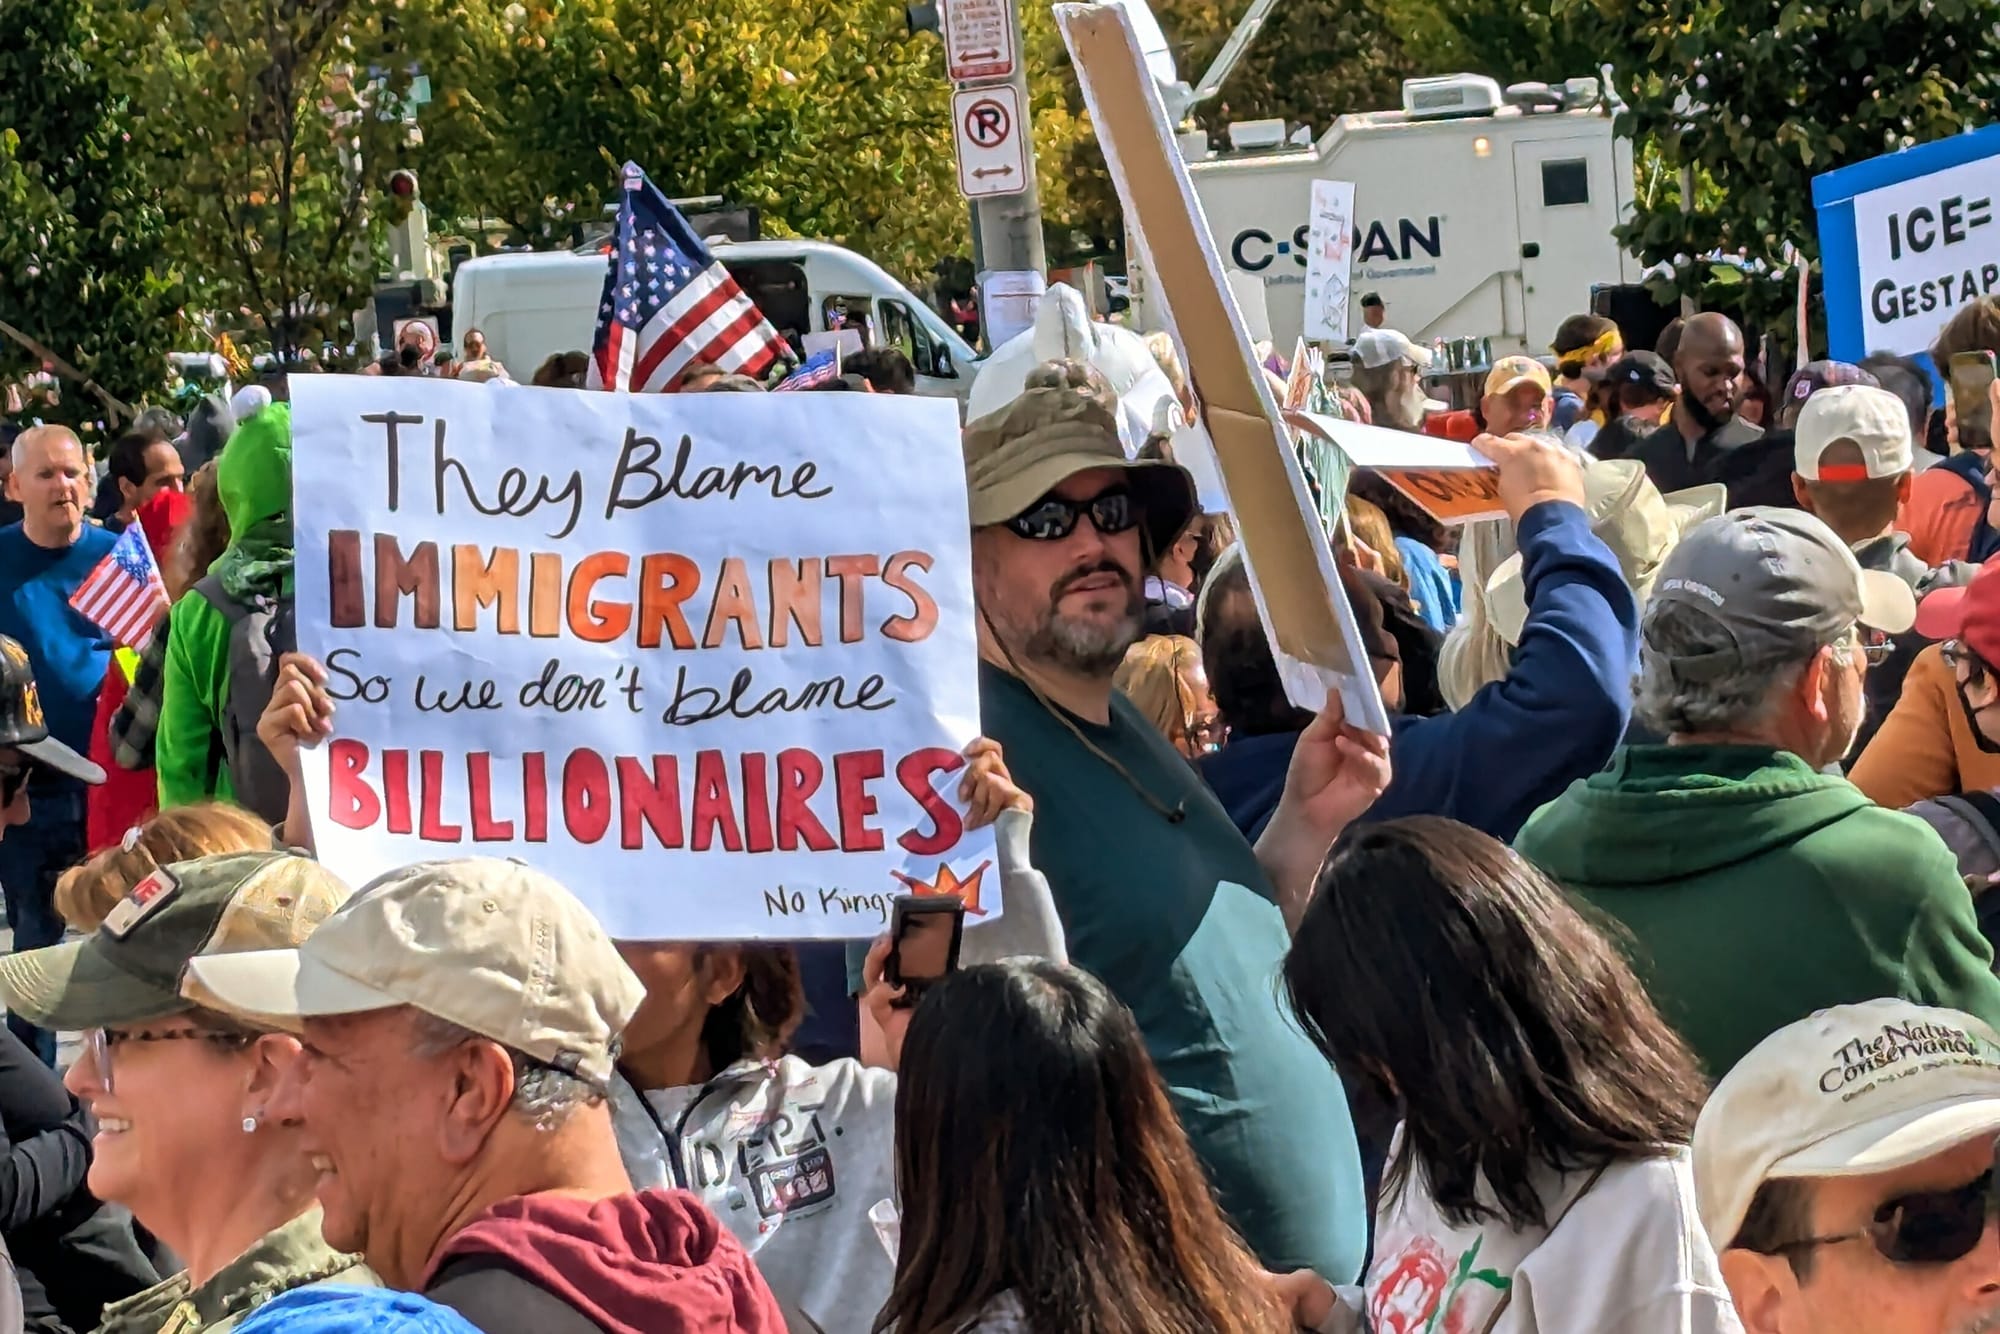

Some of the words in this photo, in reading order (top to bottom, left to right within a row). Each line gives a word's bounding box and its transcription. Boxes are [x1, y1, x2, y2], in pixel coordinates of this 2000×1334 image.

[1887, 194, 1993, 261] ICE=
[361, 410, 582, 539] They
[605, 426, 833, 520] Blame
[328, 529, 939, 649] IMMIGRANTS
[325, 648, 391, 702] So
[415, 673, 503, 713] we
[519, 658, 645, 713] don't
[662, 665, 897, 726] blame
[328, 737, 966, 855] BILLIONAIRES
[764, 885, 805, 917] No
[818, 887, 895, 925] Kings
[1833, 1037, 1884, 1064] The
